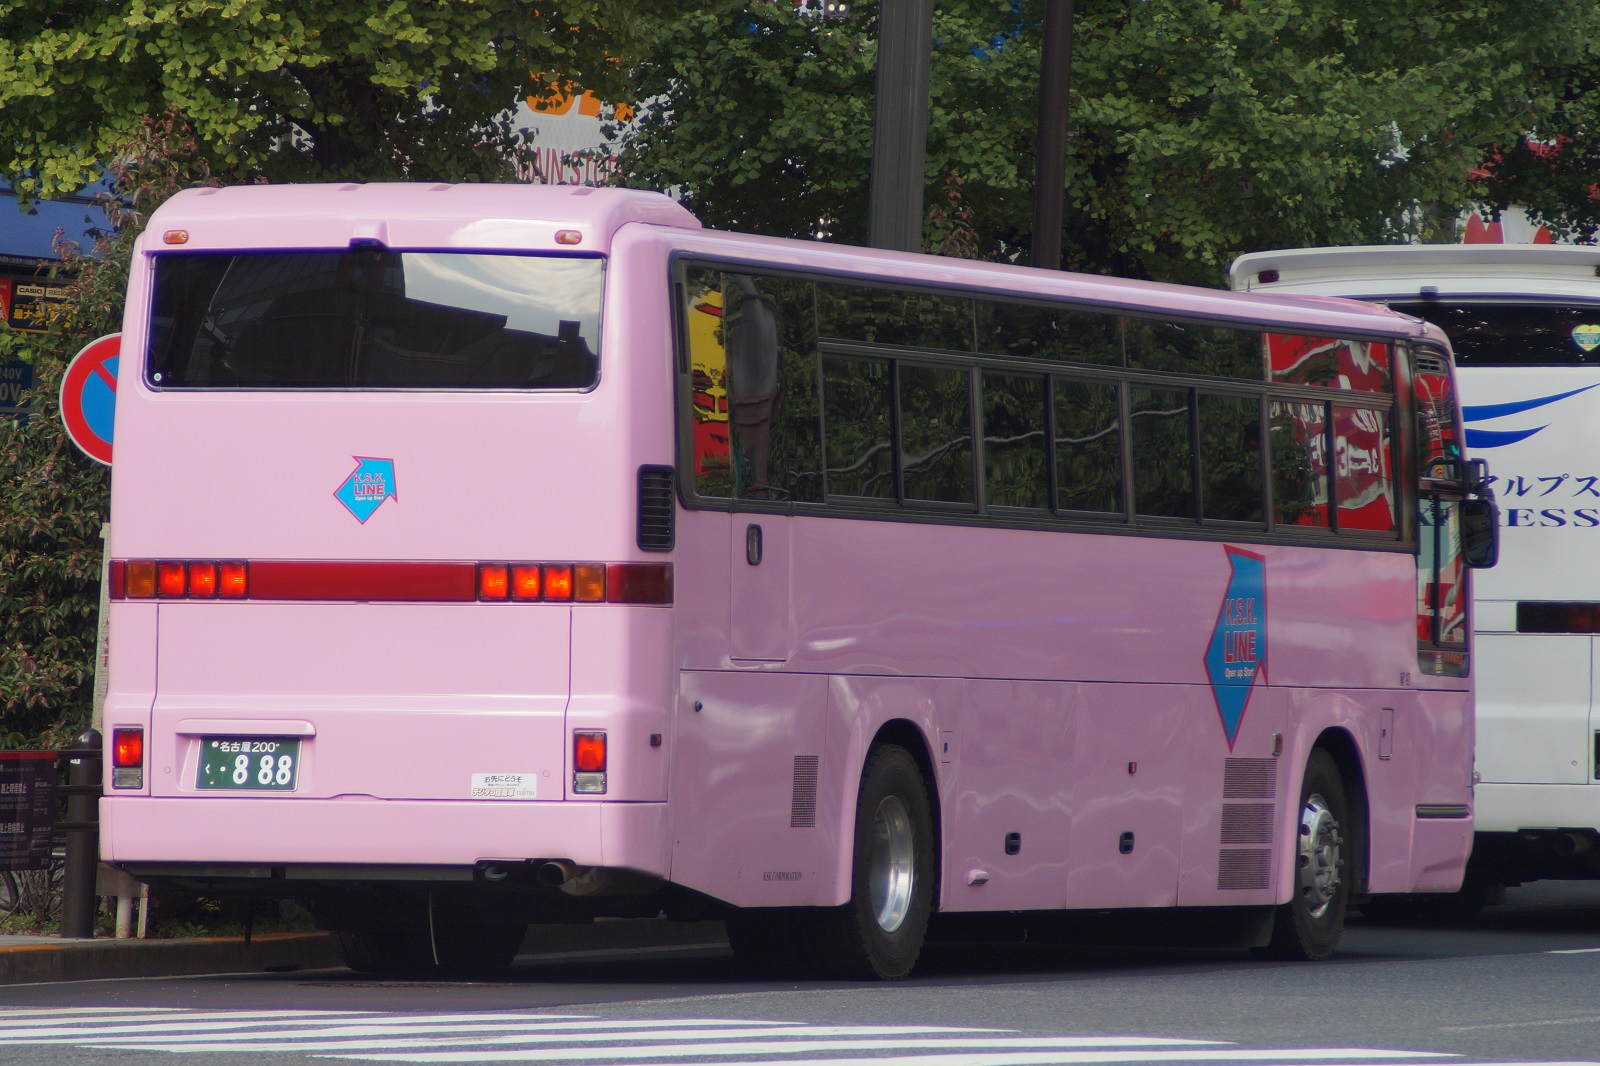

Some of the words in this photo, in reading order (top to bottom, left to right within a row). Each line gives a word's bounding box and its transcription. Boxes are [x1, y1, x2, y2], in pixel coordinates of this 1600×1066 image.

[0, 367, 23, 380] 40V
[354, 473, 385, 483] K.S.K.
[354, 484, 385, 495] LINE
[1498, 508, 1600, 528] ESS
[1225, 598, 1257, 625] K.S.K.
[1225, 630, 1256, 663] LINE
[1225, 668, 1236, 679] Open
[1237, 669, 1243, 679] up
[1244, 667, 1254, 677] Start
